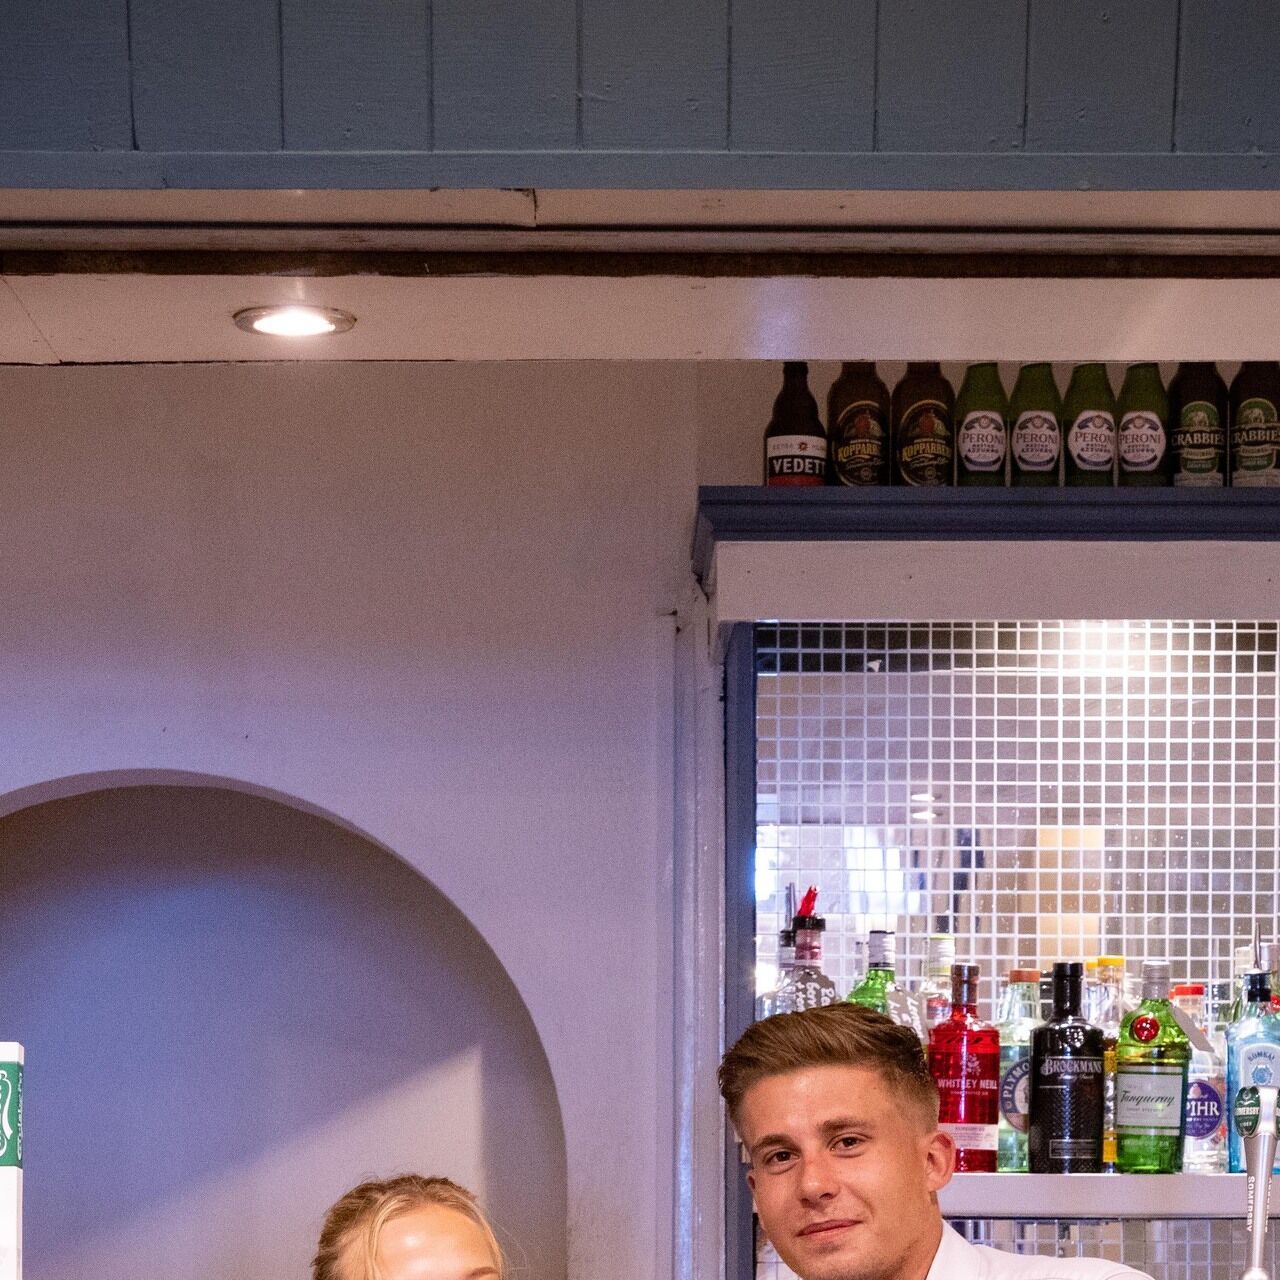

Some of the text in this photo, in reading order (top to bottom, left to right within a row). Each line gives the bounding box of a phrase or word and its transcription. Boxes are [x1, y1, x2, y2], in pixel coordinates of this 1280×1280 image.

[1040, 1058, 1103, 1077] BROCKMANS
[938, 1078, 998, 1090] WHITLEY NEILL
[1120, 1090, 1175, 1107] Tanqueray
